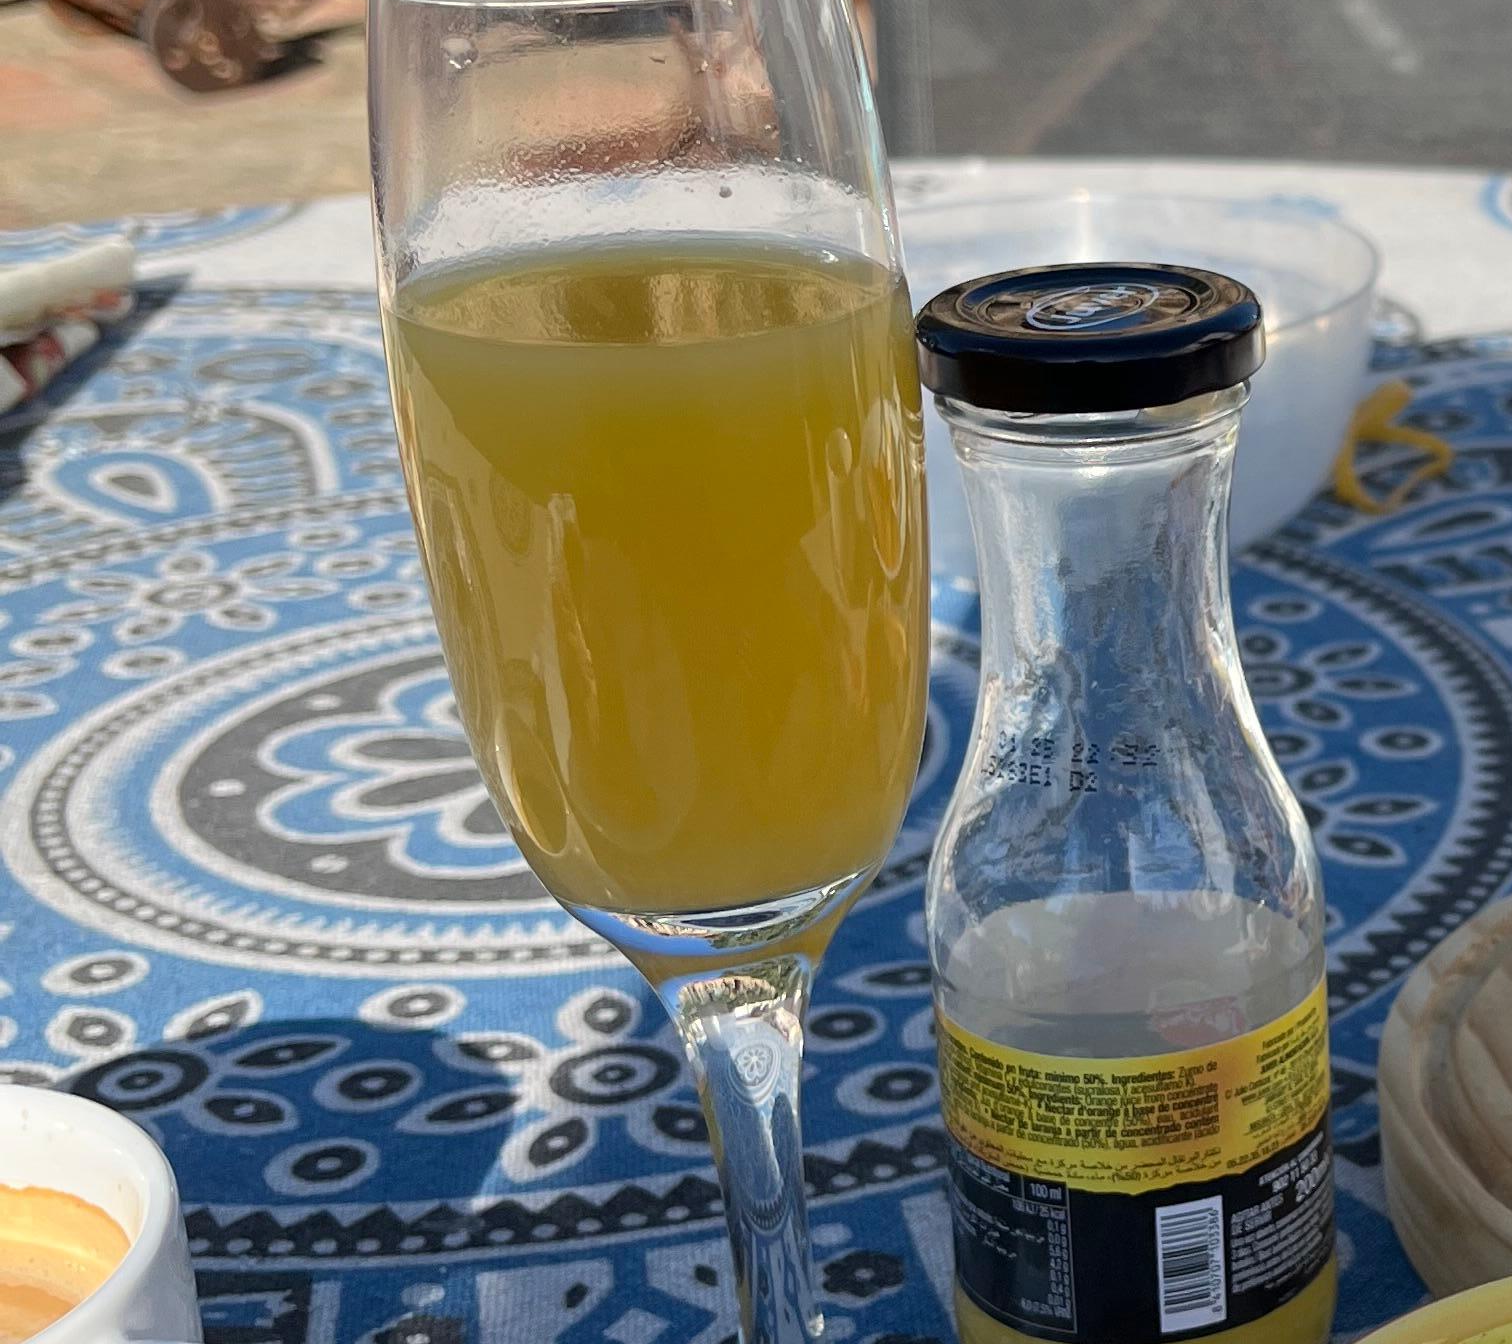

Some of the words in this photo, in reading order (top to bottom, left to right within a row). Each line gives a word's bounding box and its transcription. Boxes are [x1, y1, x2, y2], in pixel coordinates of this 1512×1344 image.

[1111, 1070, 1176, 1086] Ingredientes:
[1206, 1060, 1218, 1072] de
[1030, 1182, 1049, 1199] 100
[1049, 1186, 1062, 1201] ml
